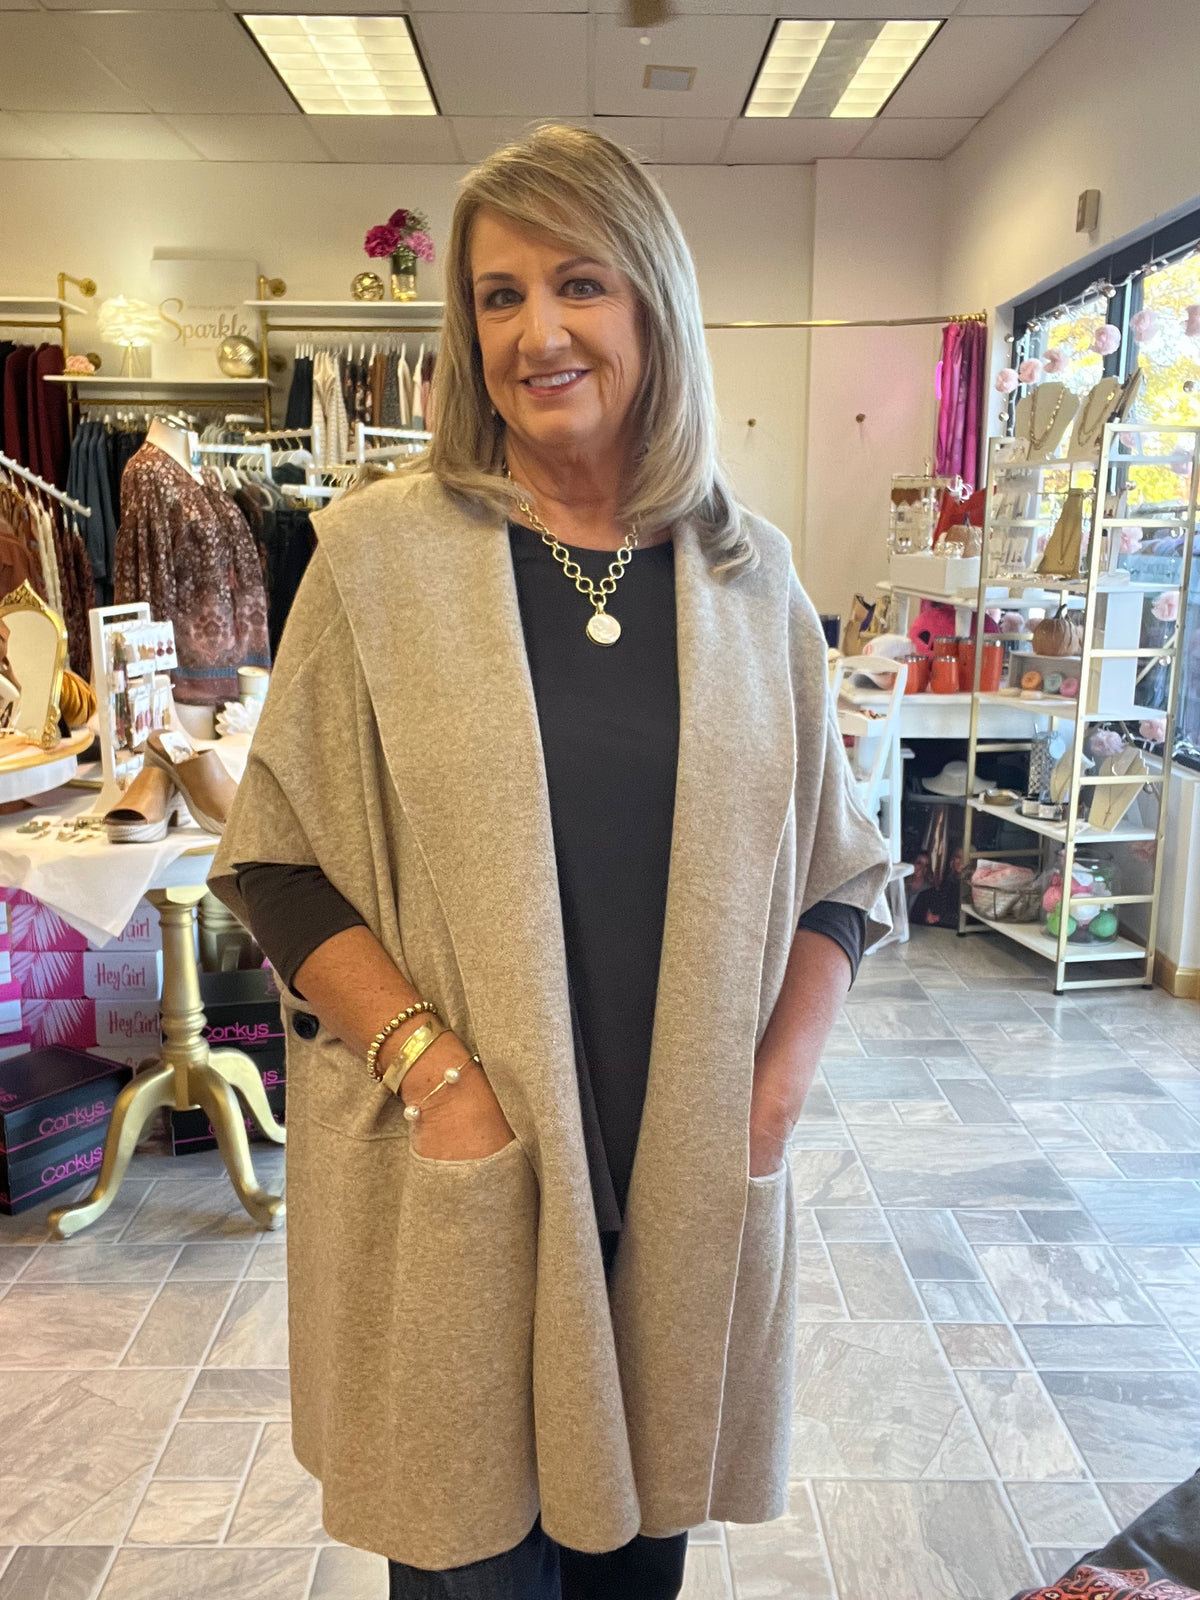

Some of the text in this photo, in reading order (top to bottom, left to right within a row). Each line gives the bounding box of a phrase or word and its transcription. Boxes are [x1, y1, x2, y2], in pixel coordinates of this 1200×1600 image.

[158, 298, 248, 348] Sparkle
[39, 1100, 105, 1137] Corkys
[41, 1147, 103, 1186] Corkys
